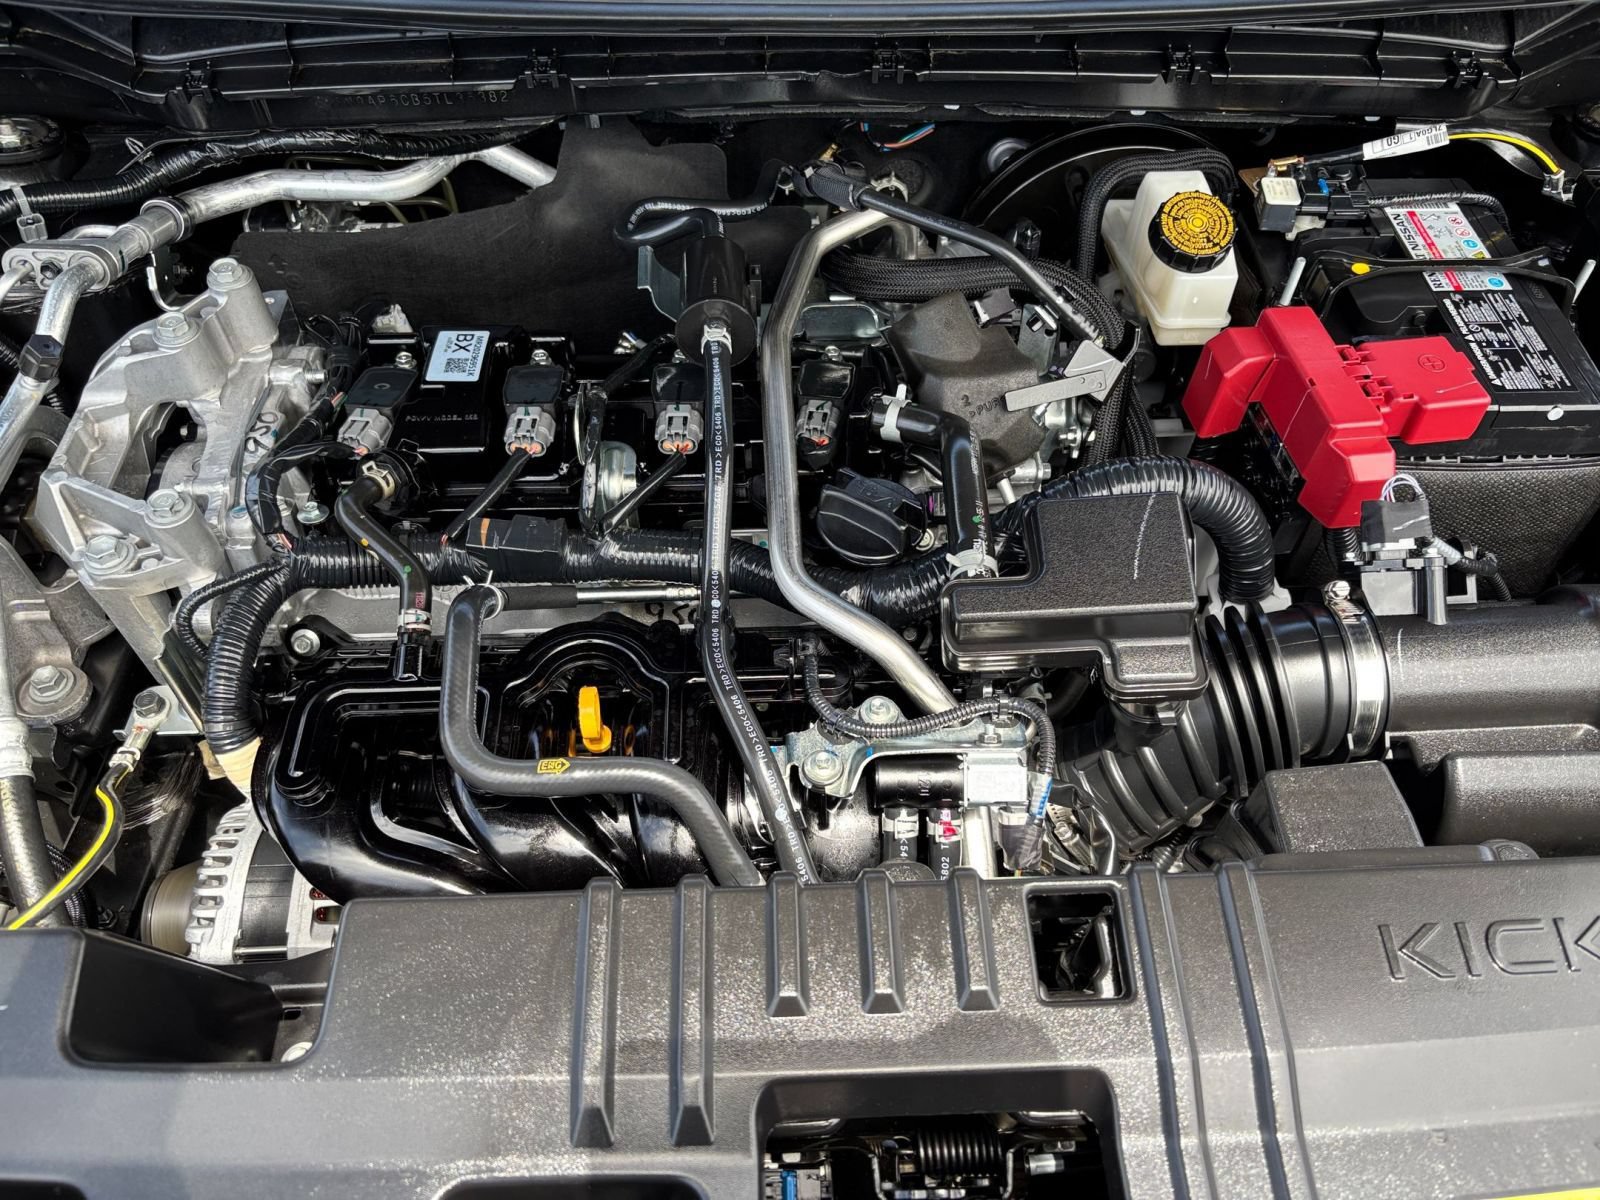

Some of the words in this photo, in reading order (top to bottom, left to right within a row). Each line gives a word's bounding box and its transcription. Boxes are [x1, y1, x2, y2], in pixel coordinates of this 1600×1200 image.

[1391, 213, 1419, 251] NISSAN
[452, 334, 475, 353] BX
[541, 760, 562, 770] ENG
